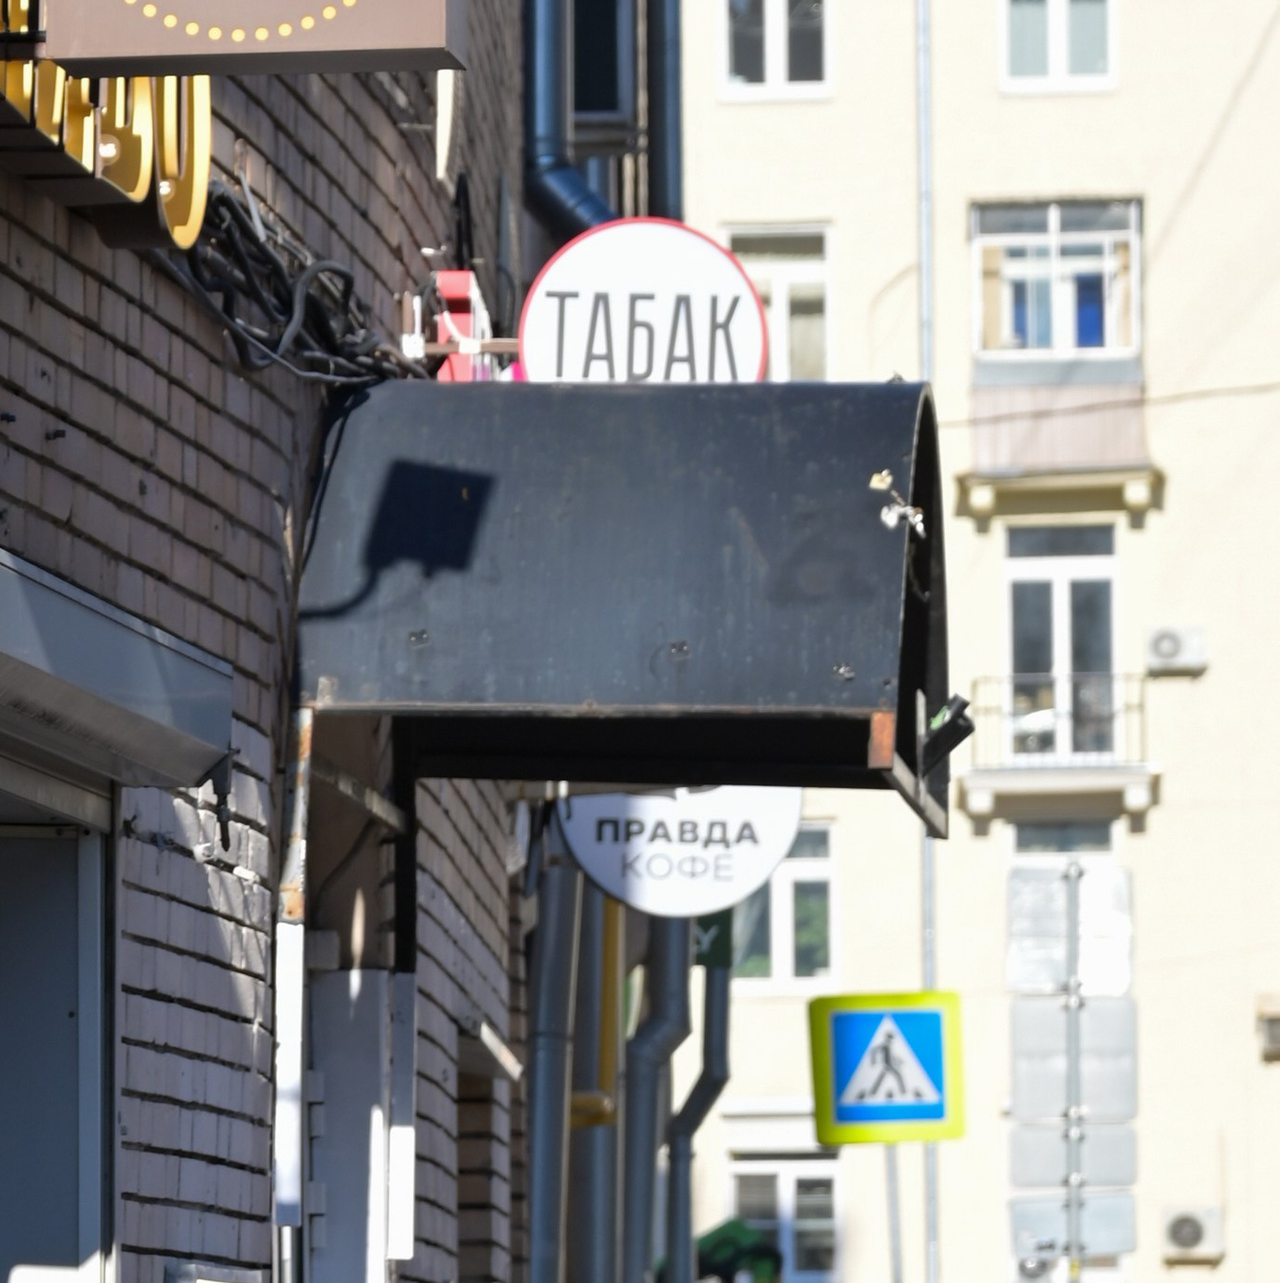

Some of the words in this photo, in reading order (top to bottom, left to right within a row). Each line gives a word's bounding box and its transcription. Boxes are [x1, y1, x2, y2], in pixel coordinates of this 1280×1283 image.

[545, 290, 741, 382] ТАБАК
[596, 819, 759, 849] ПРАВДА
[621, 852, 734, 882] КОФЕ
